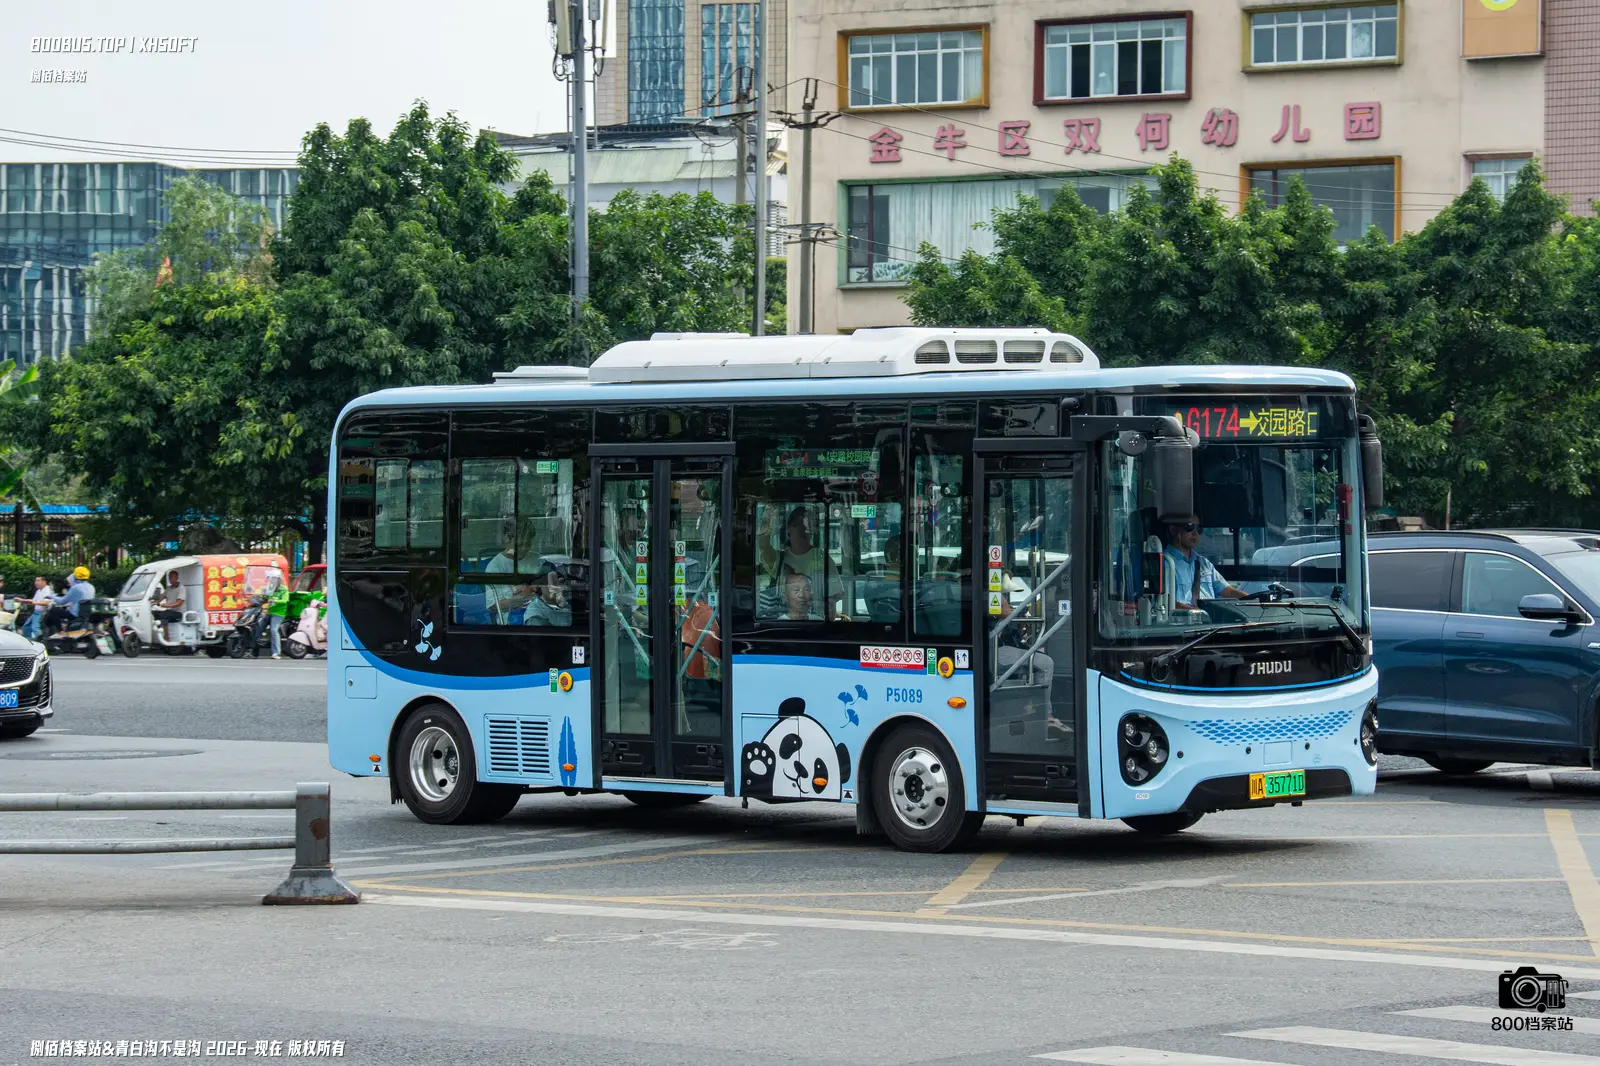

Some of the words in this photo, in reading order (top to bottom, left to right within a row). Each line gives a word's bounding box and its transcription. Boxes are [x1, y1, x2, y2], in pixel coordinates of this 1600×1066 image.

[869, 101, 1381, 163] 金牛区双何幼儿园
[1187, 406, 1240, 438] G174
[1249, 660, 1293, 675] SHUDU
[886, 687, 923, 703] P5089
